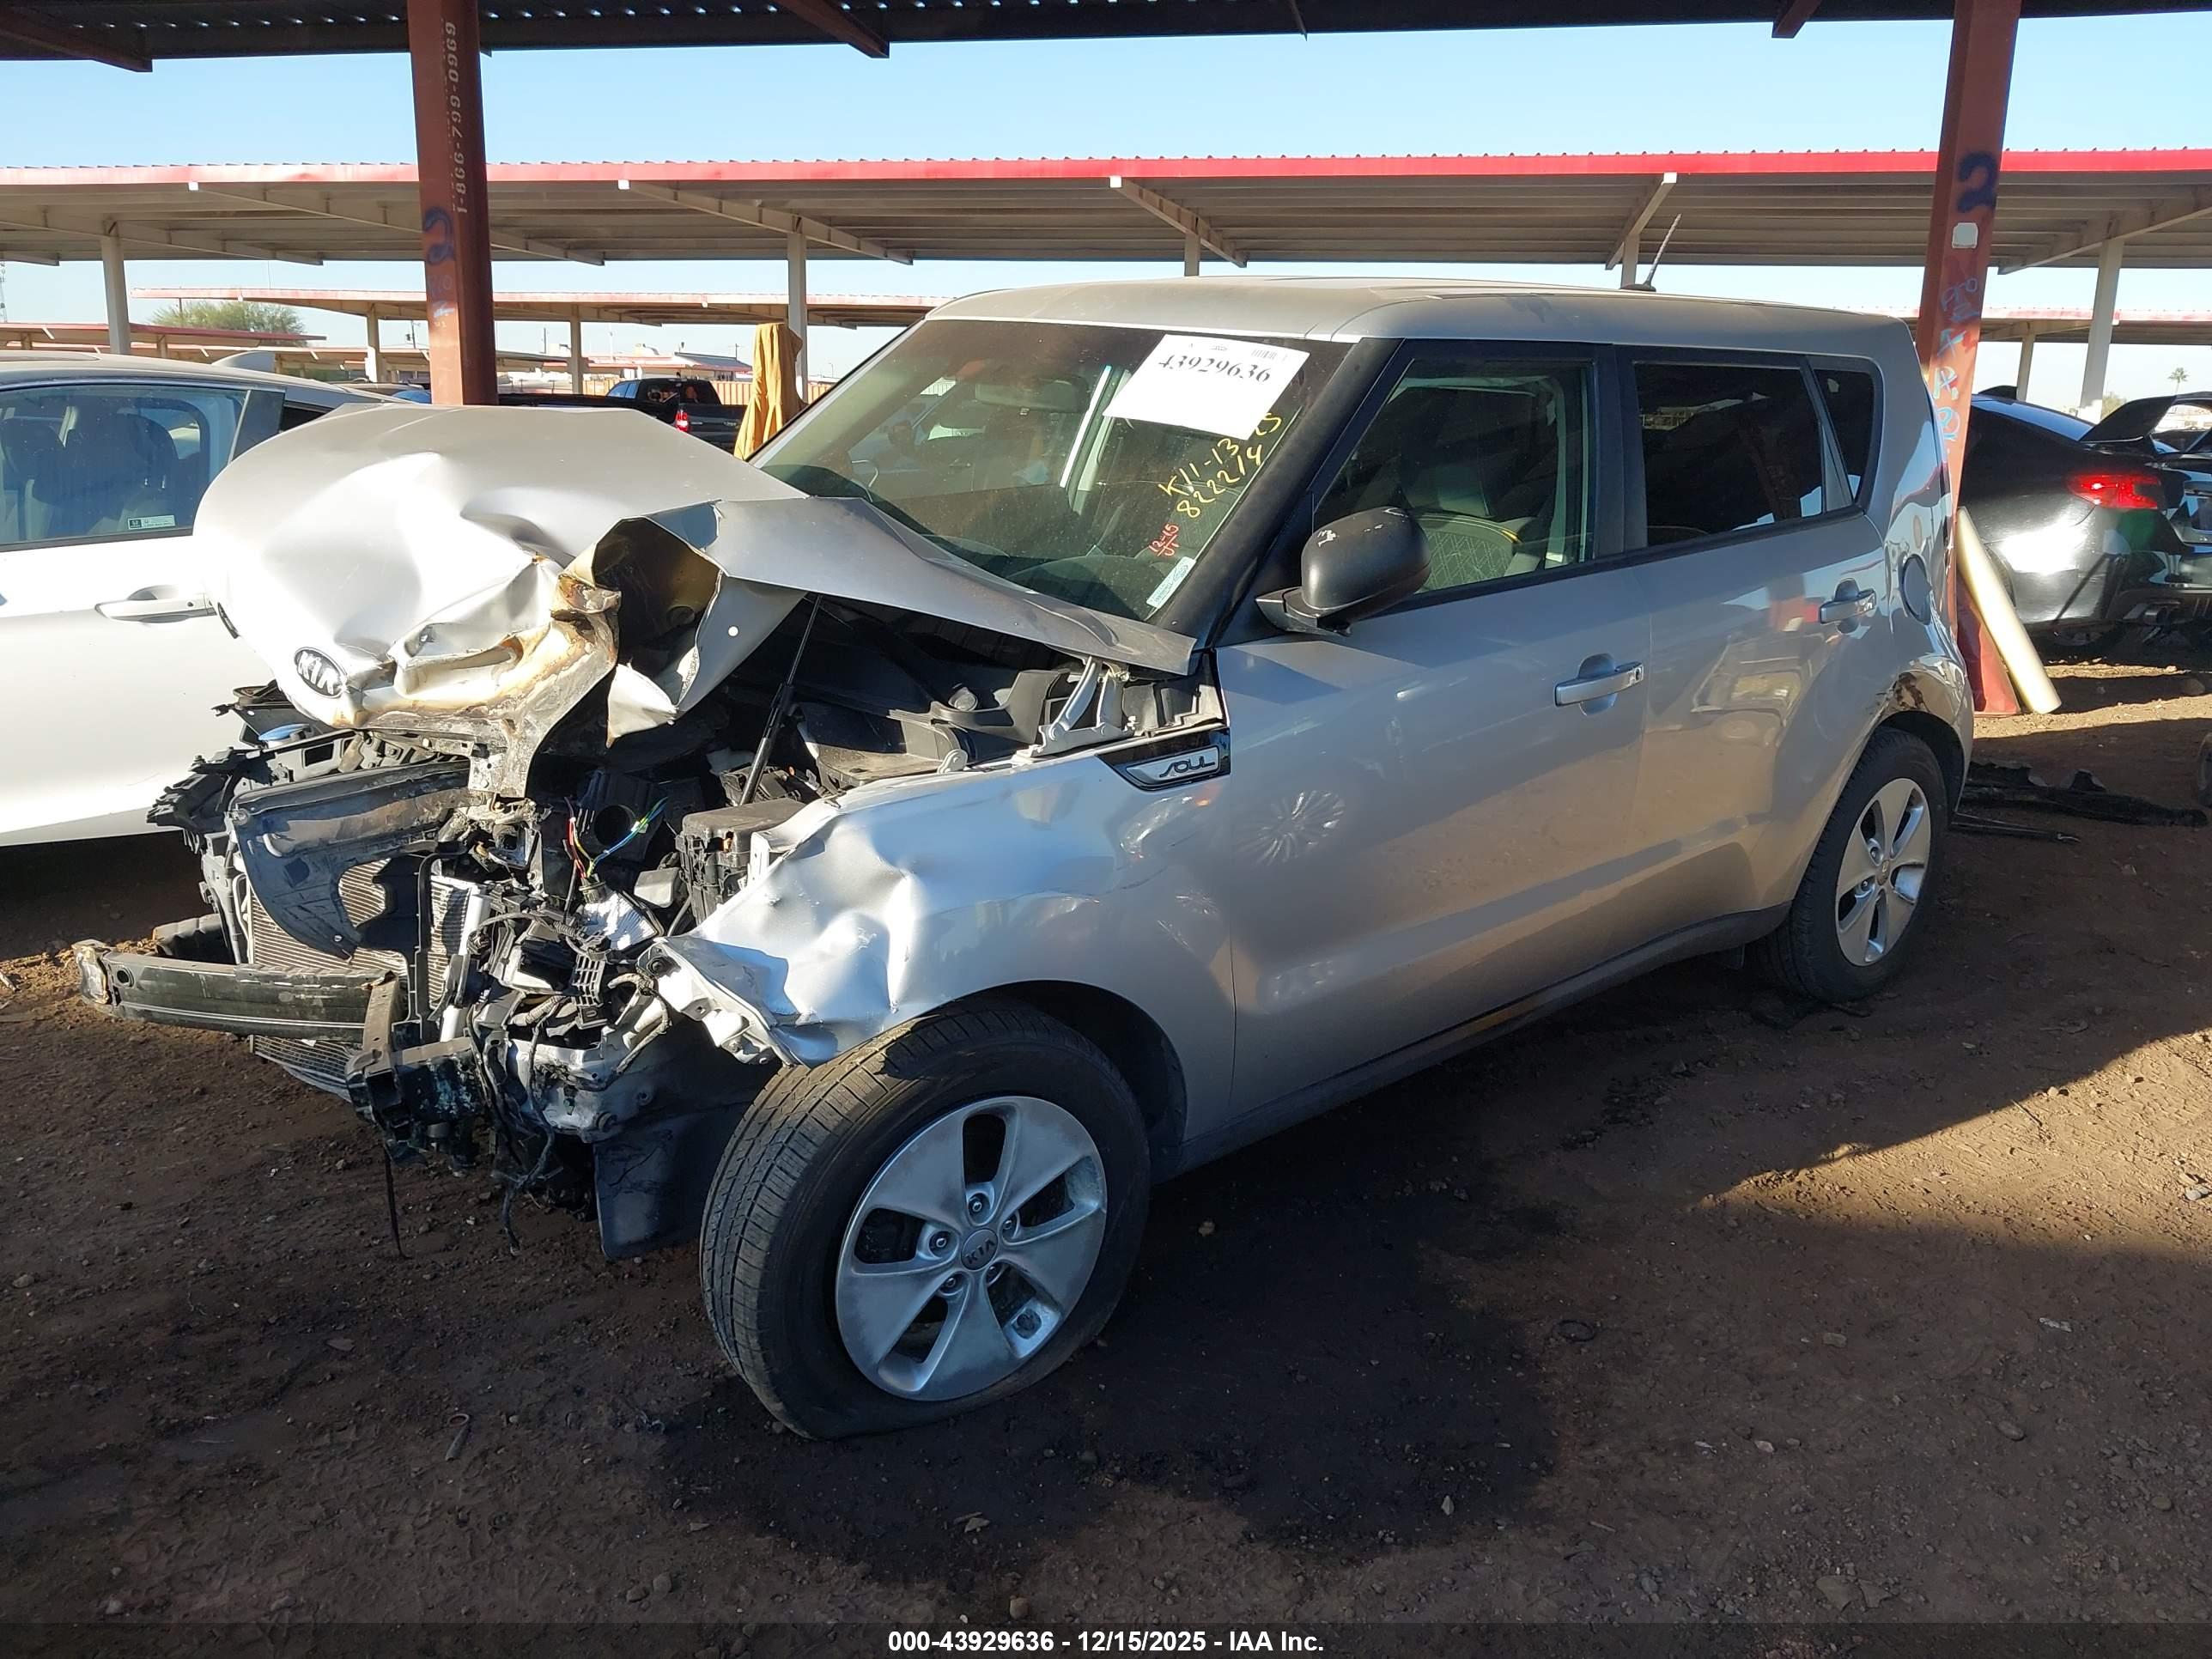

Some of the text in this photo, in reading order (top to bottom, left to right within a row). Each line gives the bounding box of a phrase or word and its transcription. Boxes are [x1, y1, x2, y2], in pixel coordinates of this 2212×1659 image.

[445, 21, 468, 214] 1-866-799-0969
[1956, 151, 1997, 213] 2
[1158, 354, 1272, 383] 43929636
[298, 650, 342, 696] KIA
[1159, 755, 1216, 779] SOUL
[964, 1237, 996, 1265] KIA
